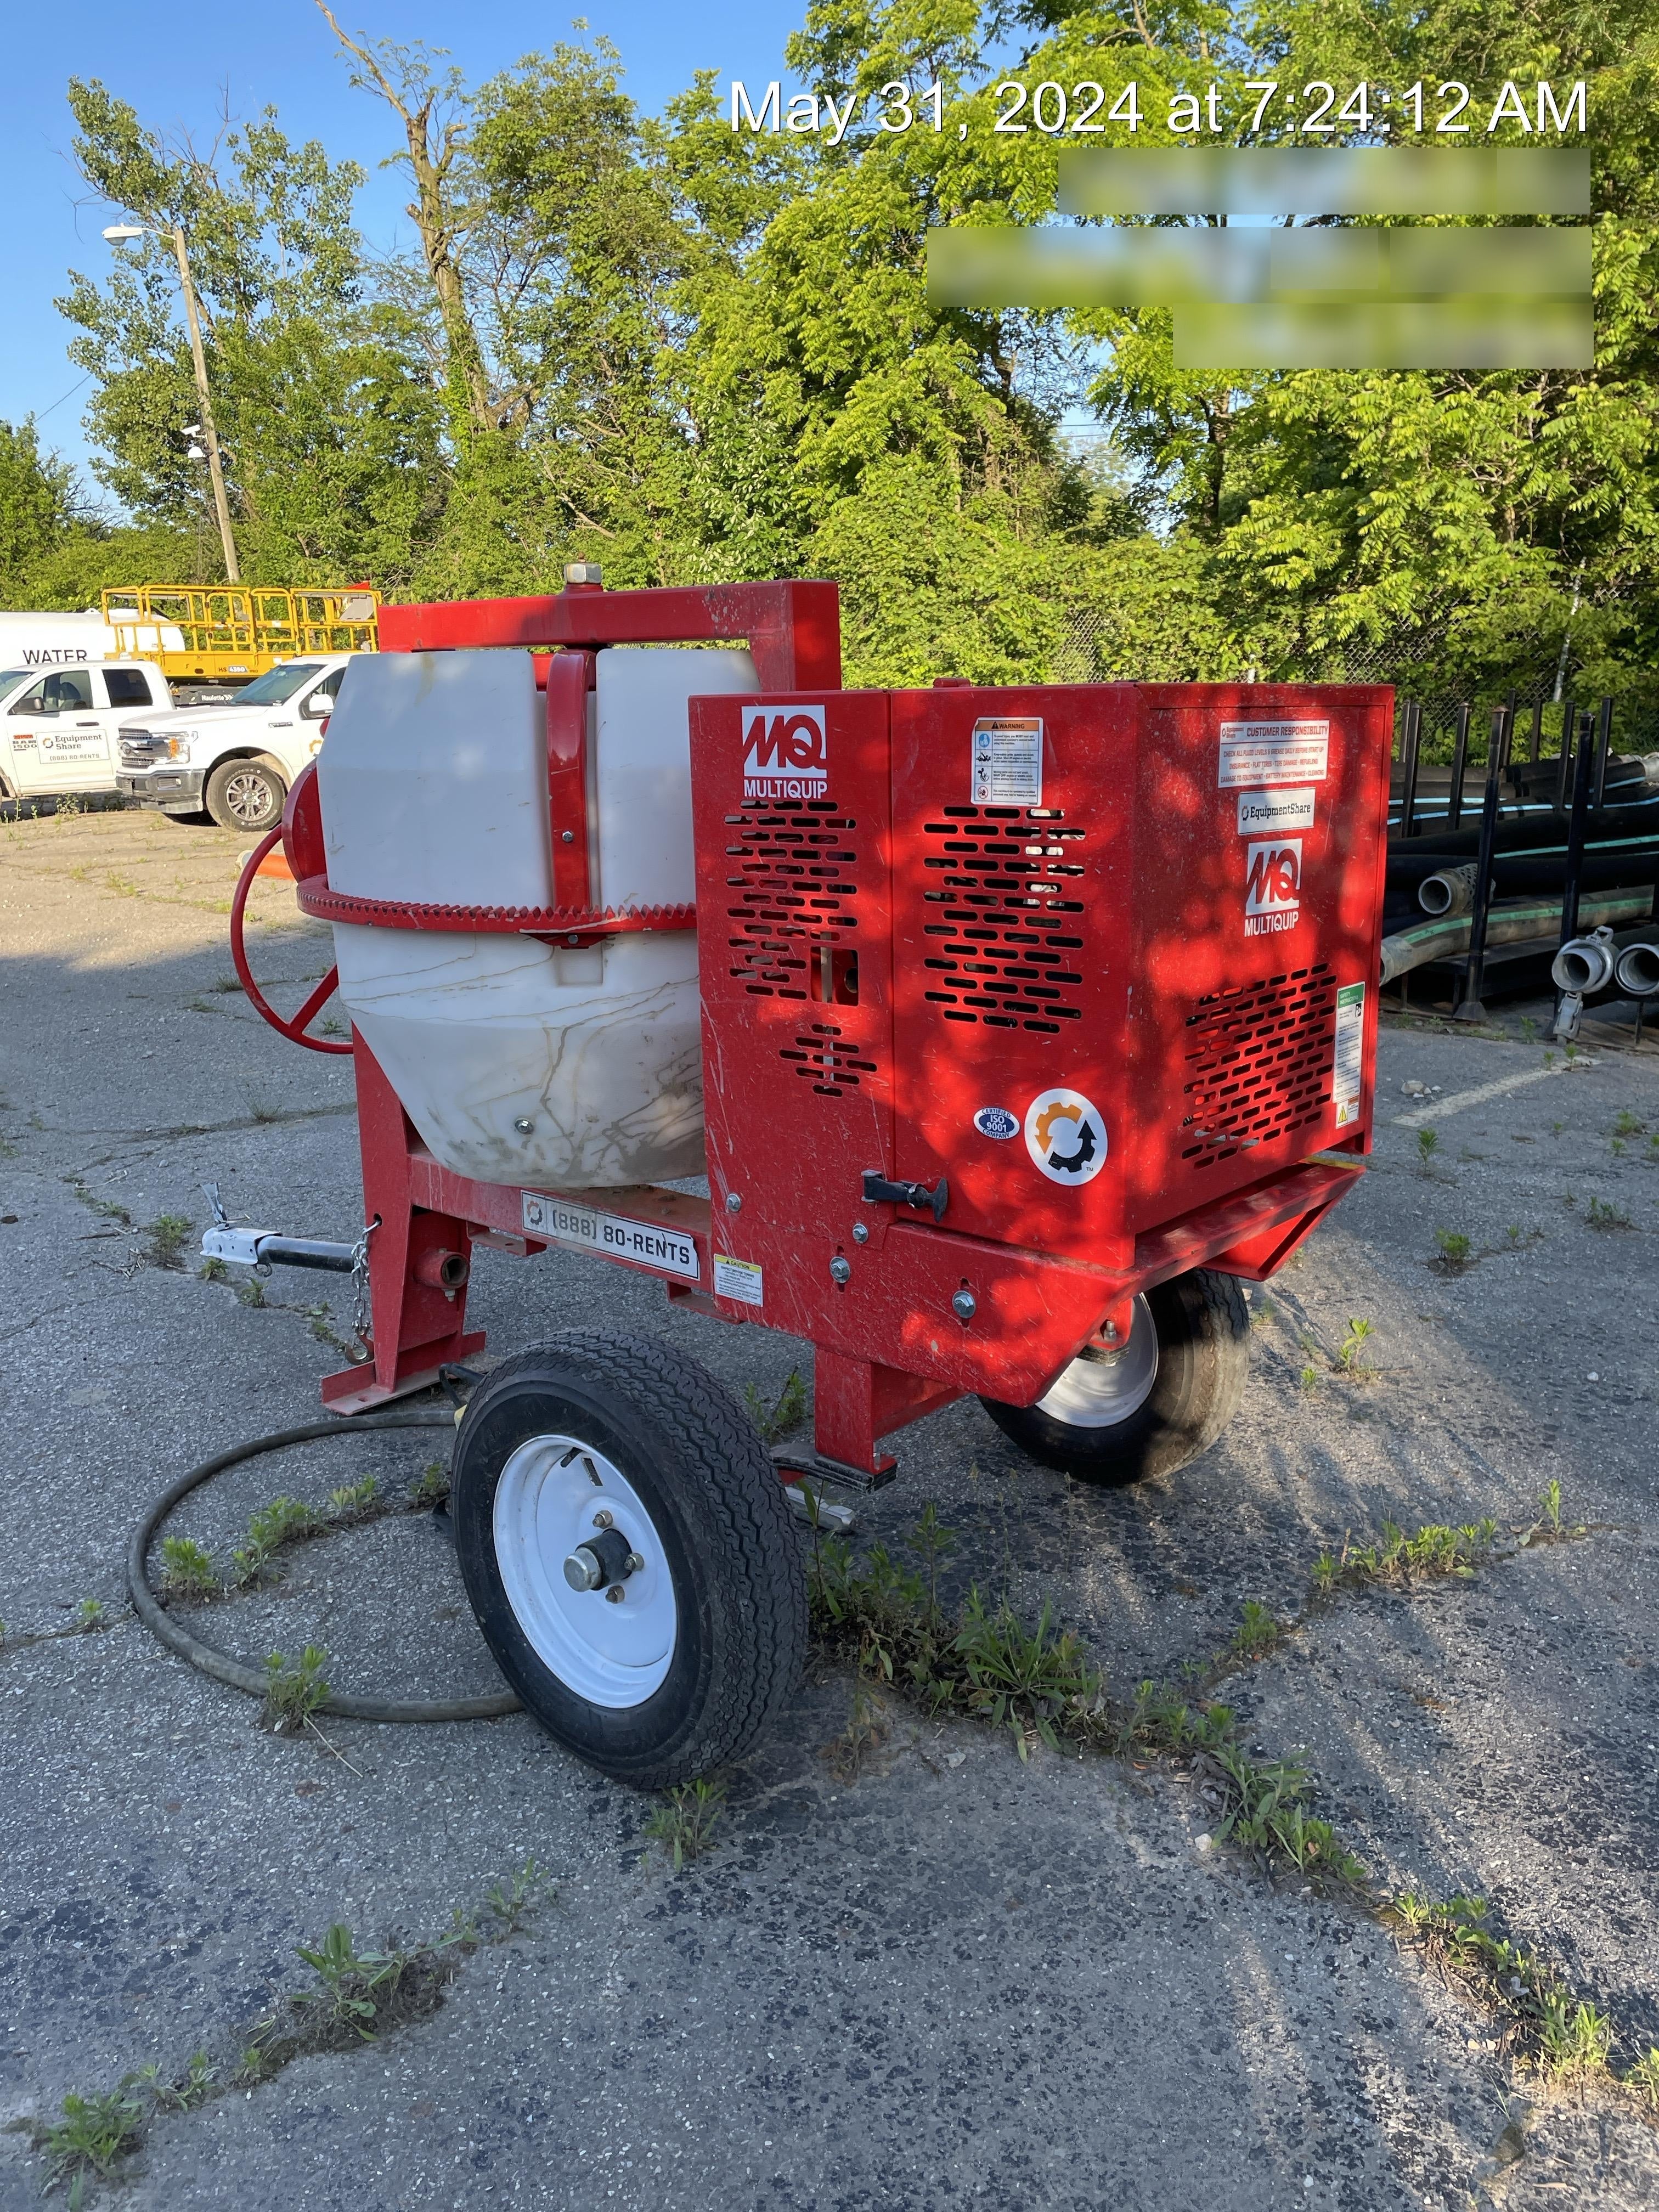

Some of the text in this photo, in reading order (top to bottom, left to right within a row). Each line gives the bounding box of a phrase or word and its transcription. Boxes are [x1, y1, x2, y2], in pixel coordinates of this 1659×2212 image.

[22, 650, 87, 664] WATER
[1247, 725, 1328, 737] CUSTOMER RESPONSIBILITY
[55, 733, 103, 742] Equipment
[742, 713, 827, 769] MQ
[1242, 774, 1263, 782] EQUIPMENT
[744, 779, 827, 799] MULTIQUIP
[1250, 803, 1311, 820] EquipmentShare
[1247, 848, 1300, 905] MQ
[1244, 911, 1299, 937] MULTIQUIP
[981, 1108, 1011, 1118] CERTIFIED
[990, 1114, 1005, 1124] ISO
[983, 1128, 1010, 1138] COMPANY
[986, 1122, 1007, 1132] 9001
[552, 1209, 690, 1265] (888) 80-RENTS
[730, 1261, 750, 1269] CAUTION
